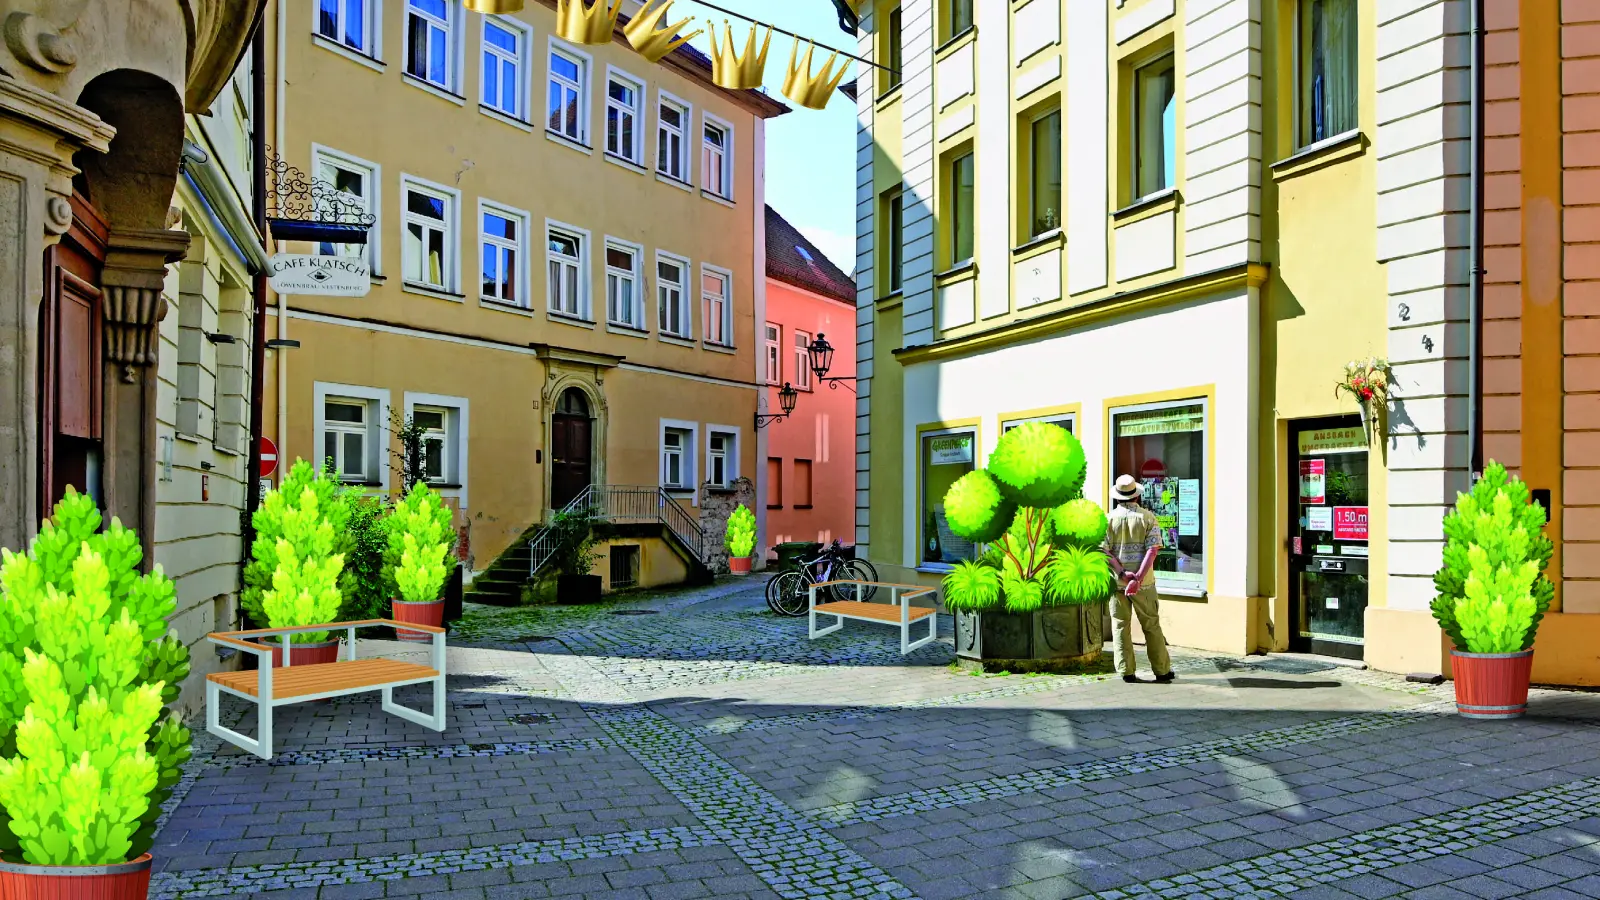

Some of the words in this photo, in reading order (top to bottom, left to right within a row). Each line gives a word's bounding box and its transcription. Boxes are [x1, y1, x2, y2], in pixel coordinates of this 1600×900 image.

[309, 257, 366, 277] KLATSCH
[1313, 430, 1356, 440] ANSBACH
[1358, 514, 1367, 522] m
